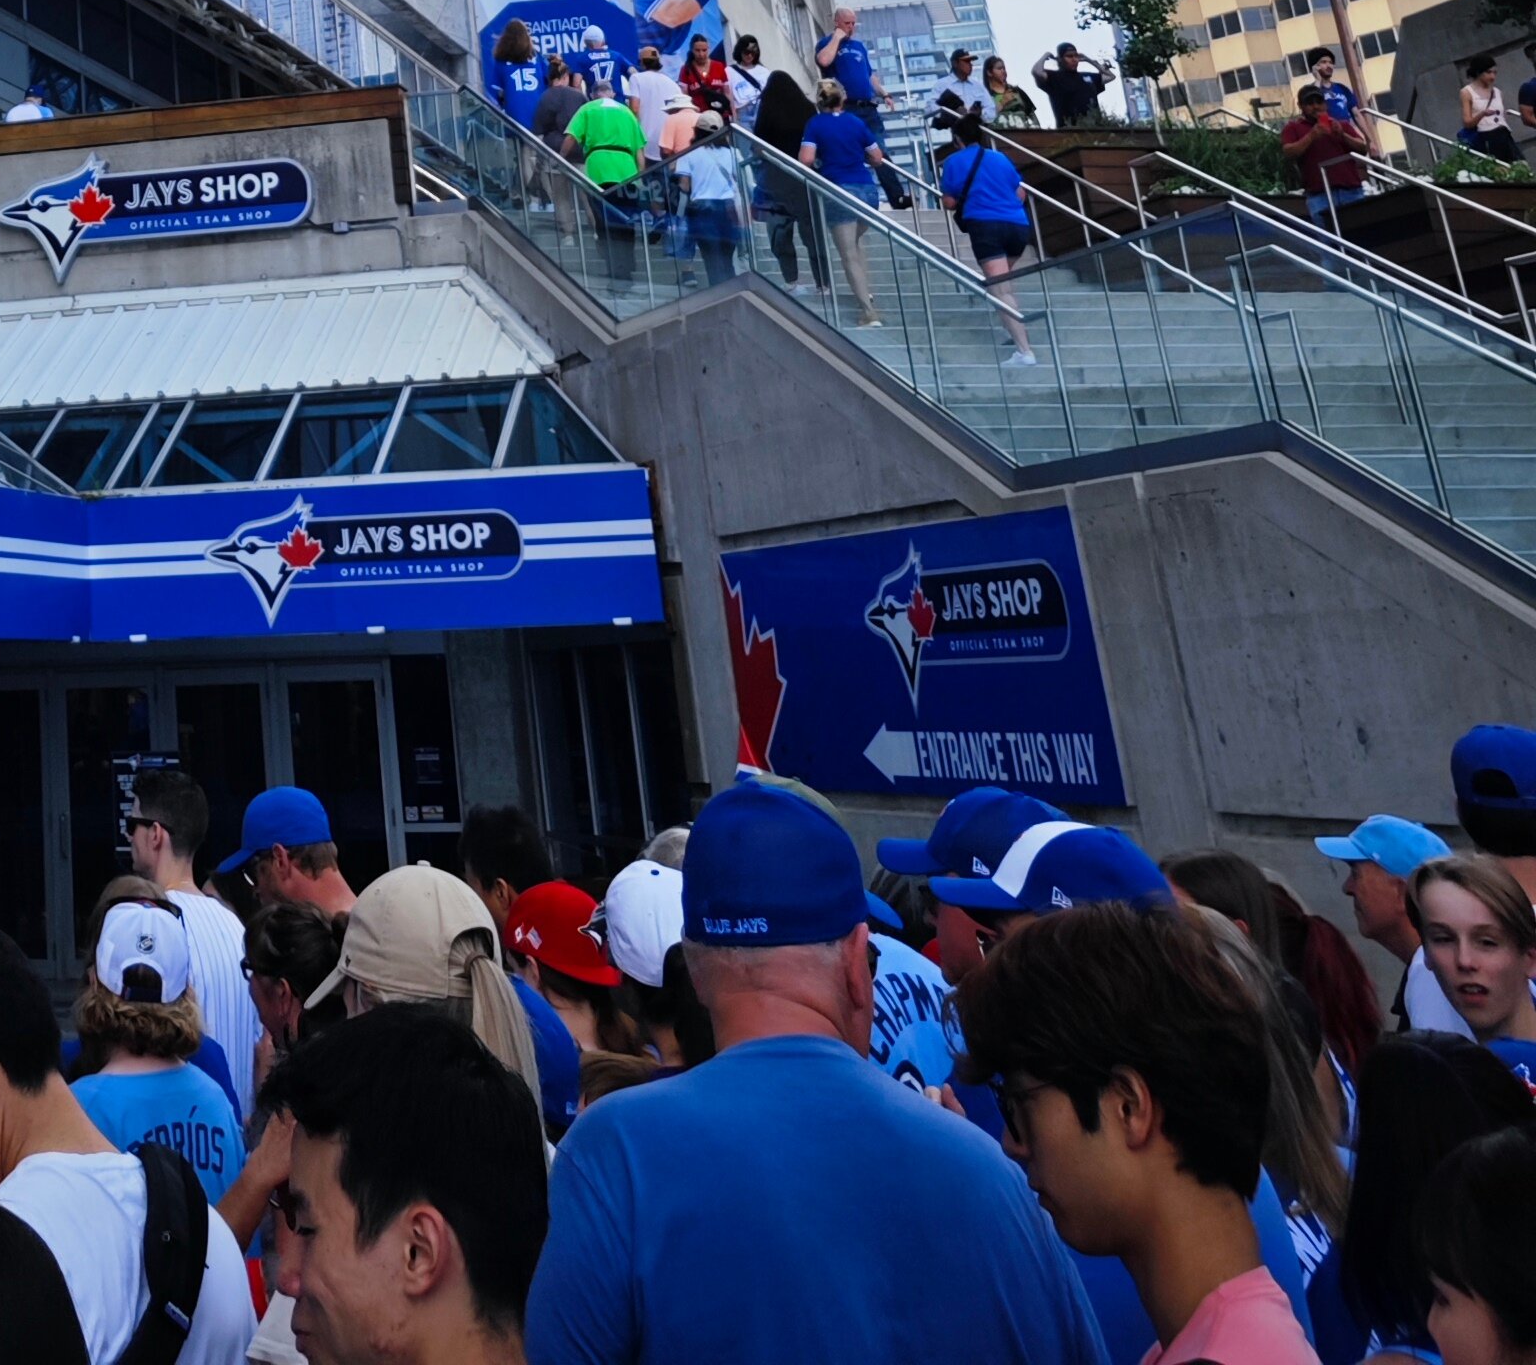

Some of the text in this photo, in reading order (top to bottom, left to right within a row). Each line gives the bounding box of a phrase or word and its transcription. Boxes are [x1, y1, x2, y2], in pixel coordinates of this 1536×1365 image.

[524, 16, 590, 35] SANTIAGO
[530, 31, 588, 56] SPIN
[510, 67, 539, 91] 15
[589, 61, 615, 83] 17
[124, 171, 280, 210] JAYS SHOP
[129, 210, 272, 230] OFFICIAL TEAM SHOP
[334, 522, 491, 555] JAYS SHOP
[340, 562, 484, 577] OFFICIAL TEAM SHOP
[942, 577, 1042, 621] JAYS SHOP
[949, 635, 1044, 651] OFFICIAL TEAM SHOP
[916, 730, 1099, 786] ENTRANCE THIS WAY
[702, 916, 769, 935] BLUE JAYS
